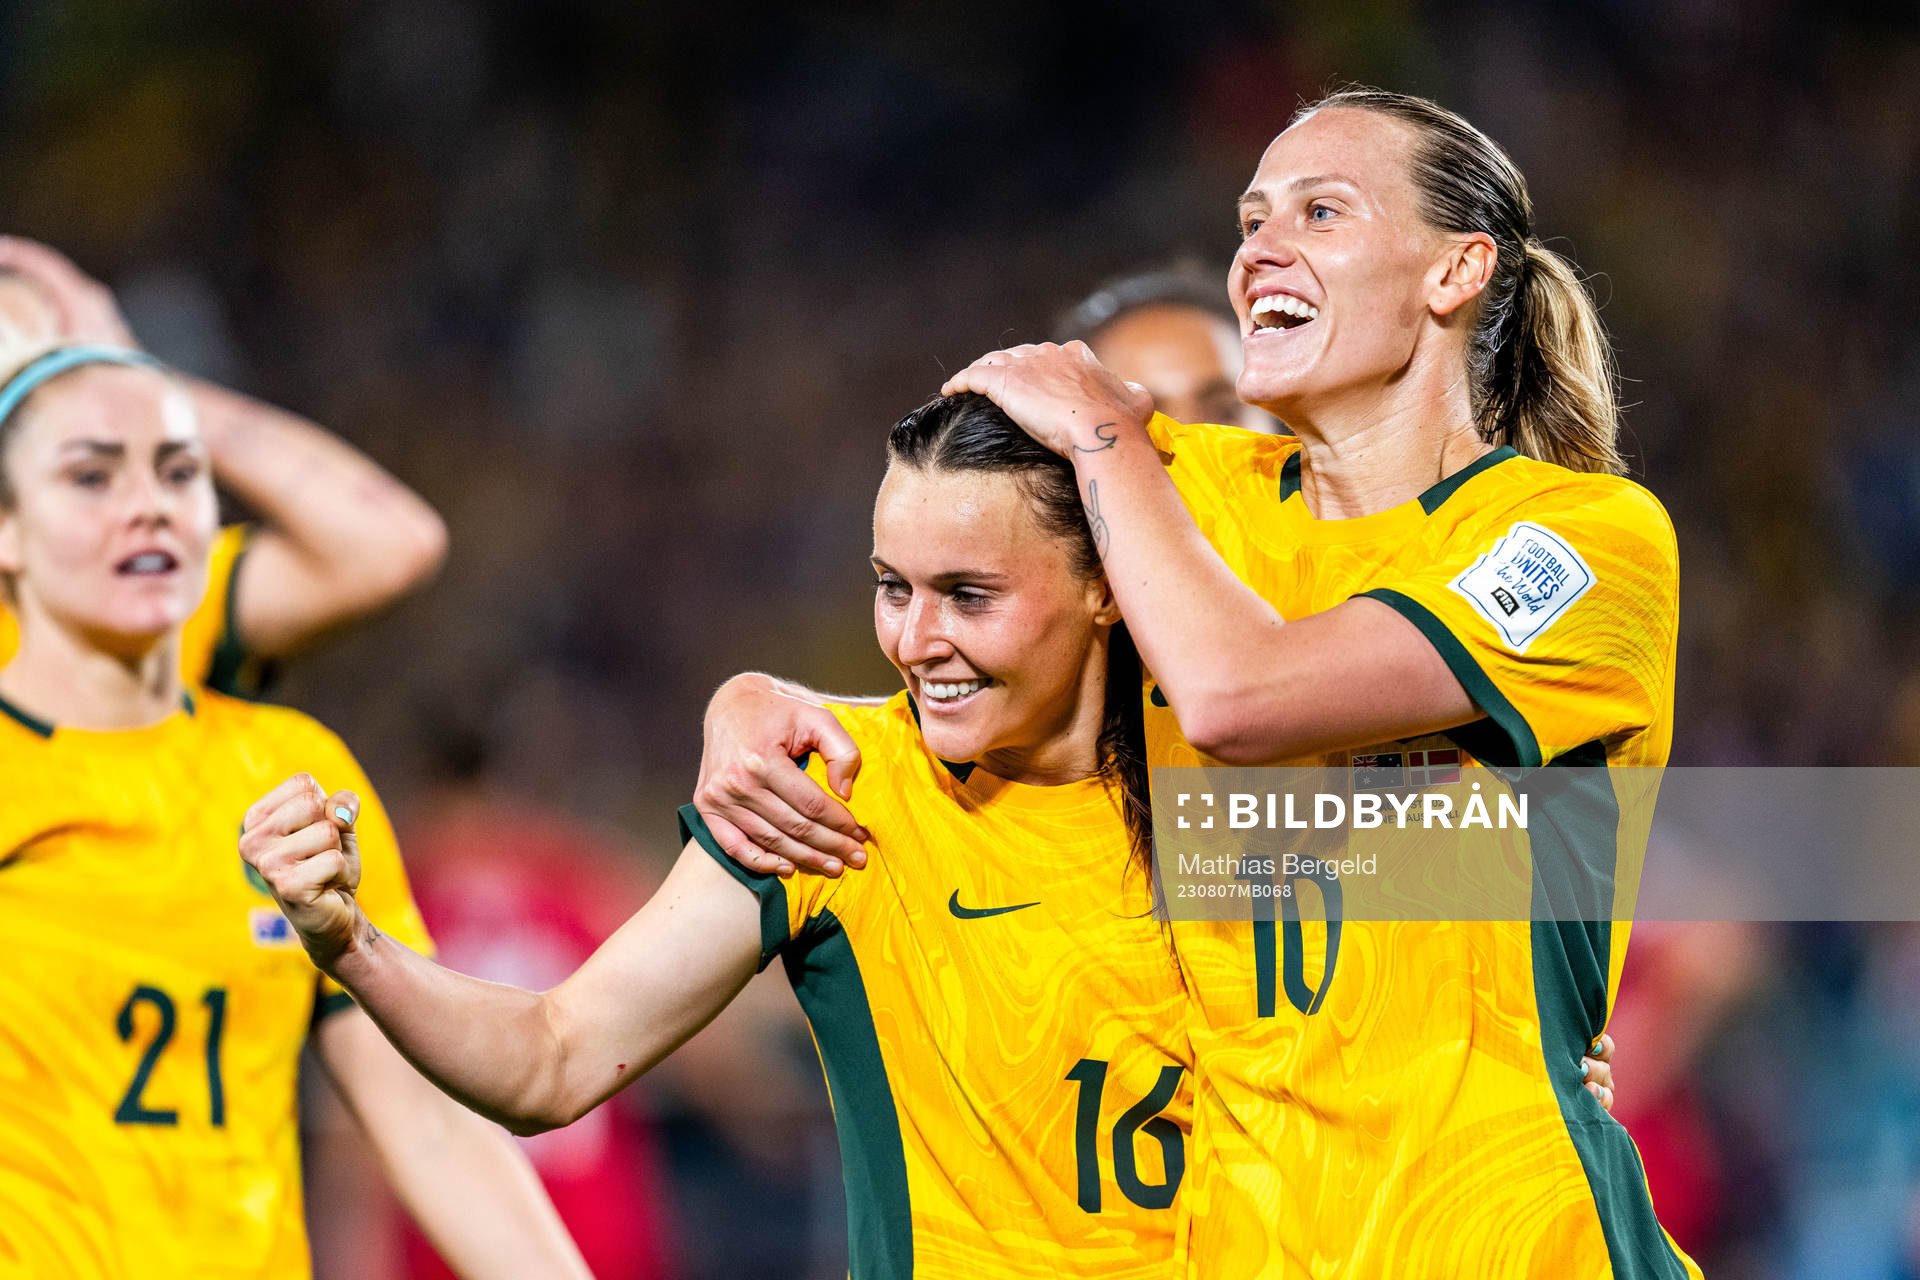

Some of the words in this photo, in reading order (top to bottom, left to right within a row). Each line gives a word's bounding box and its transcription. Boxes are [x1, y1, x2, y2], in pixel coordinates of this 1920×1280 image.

[1510, 551, 1559, 600] UNITES
[1511, 577, 1546, 615] World
[1522, 539, 1570, 587] FOOTBALL
[1234, 854, 1344, 1018] 10
[114, 984, 227, 1127] 21
[1064, 1058, 1186, 1214] 16
